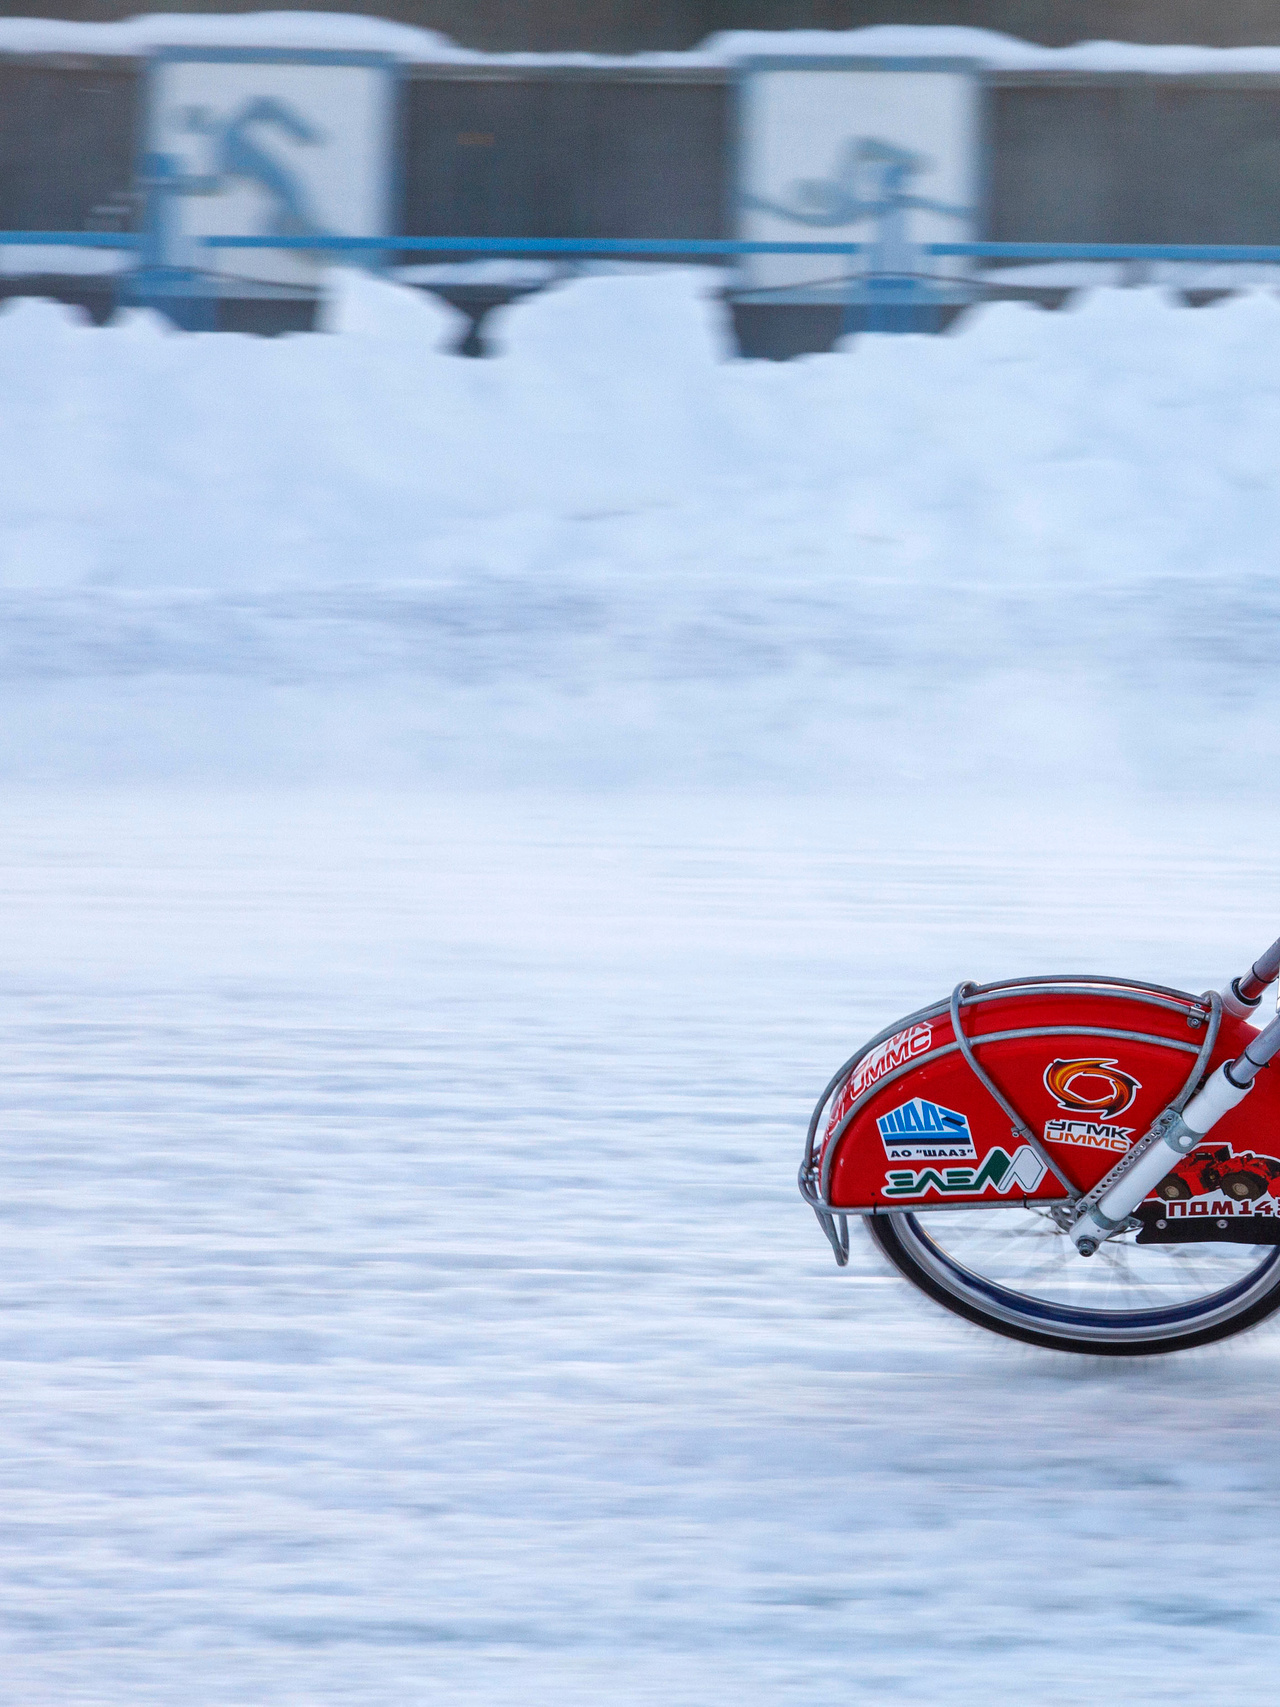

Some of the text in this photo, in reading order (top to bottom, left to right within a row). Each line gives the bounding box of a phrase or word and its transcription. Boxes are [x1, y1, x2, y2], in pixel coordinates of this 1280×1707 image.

[1046, 1120, 1130, 1141] УГМК
[1046, 1130, 1129, 1151] UMMC
[890, 1150, 912, 1158] АО
[1167, 1200, 1274, 1217] ПДМ 14
